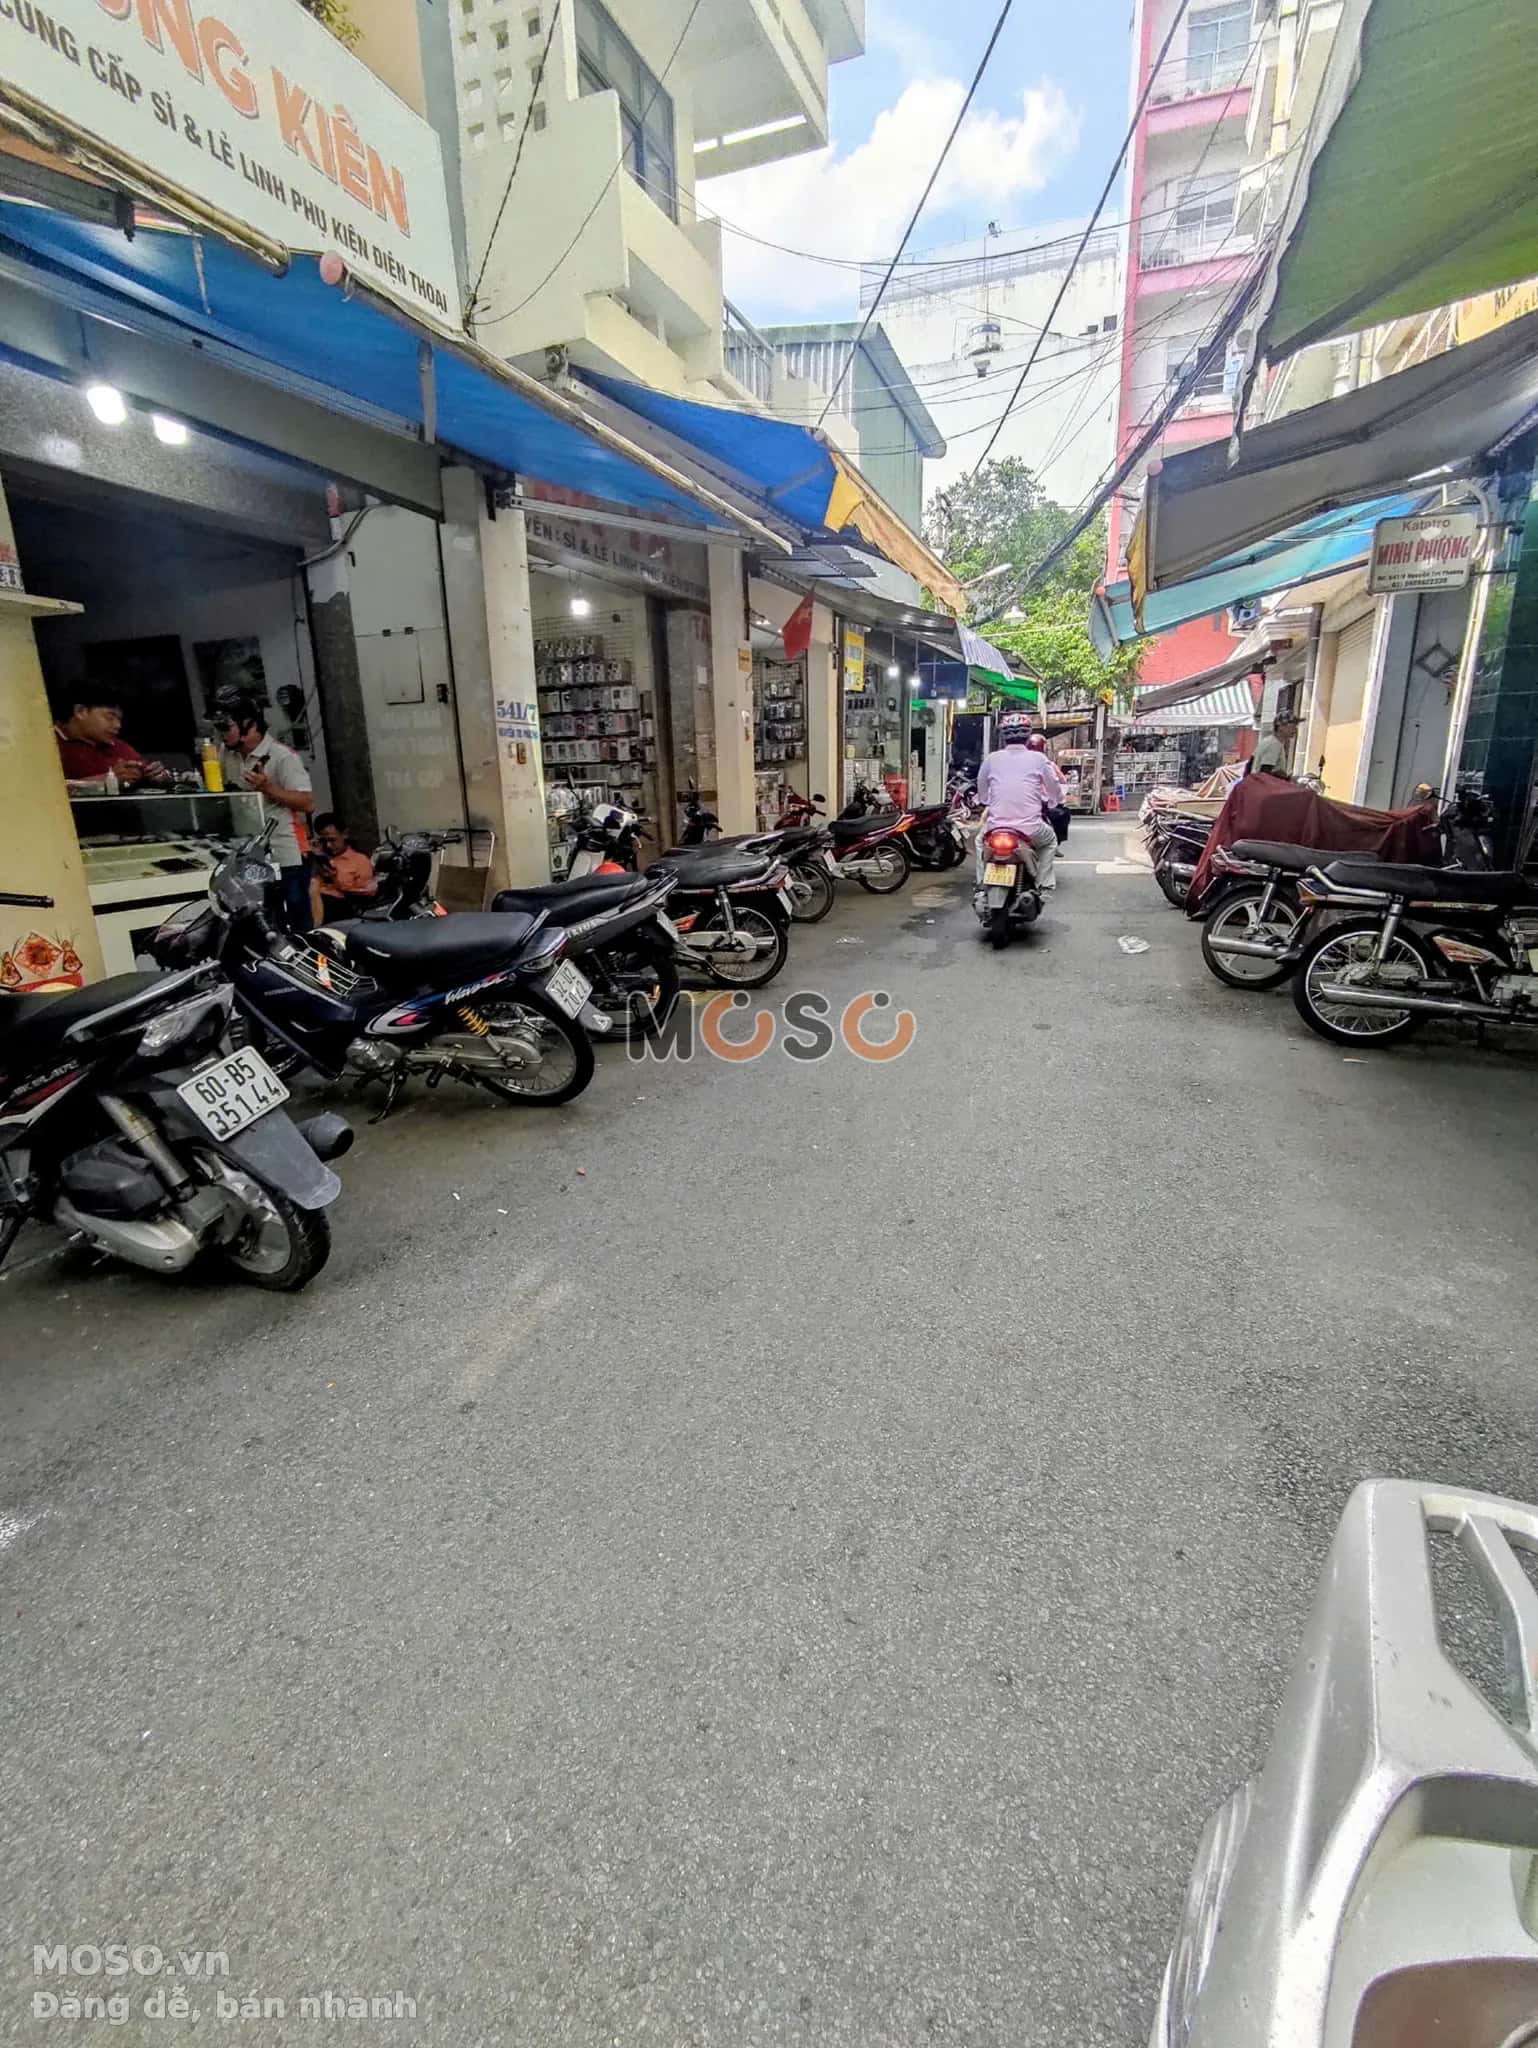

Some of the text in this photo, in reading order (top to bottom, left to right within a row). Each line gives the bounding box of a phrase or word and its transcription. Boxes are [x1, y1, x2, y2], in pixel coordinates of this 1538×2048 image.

[95, 0, 411, 238] NG KIÊN
[88, 46, 142, 104] CẤP
[151, 91, 177, 132] SỈ
[183, 113, 203, 150] &
[207, 129, 235, 170] LẺ
[240, 152, 286, 205] LINH
[290, 187, 328, 238] PHỤ
[331, 217, 369, 261] KIỆN
[372, 244, 407, 285] ĐIỆN
[409, 271, 448, 314] THOẠI
[1377, 541, 1413, 566] MINH
[195, 1057, 256, 1104] 60-B5
[207, 1076, 281, 1136] 351.44
